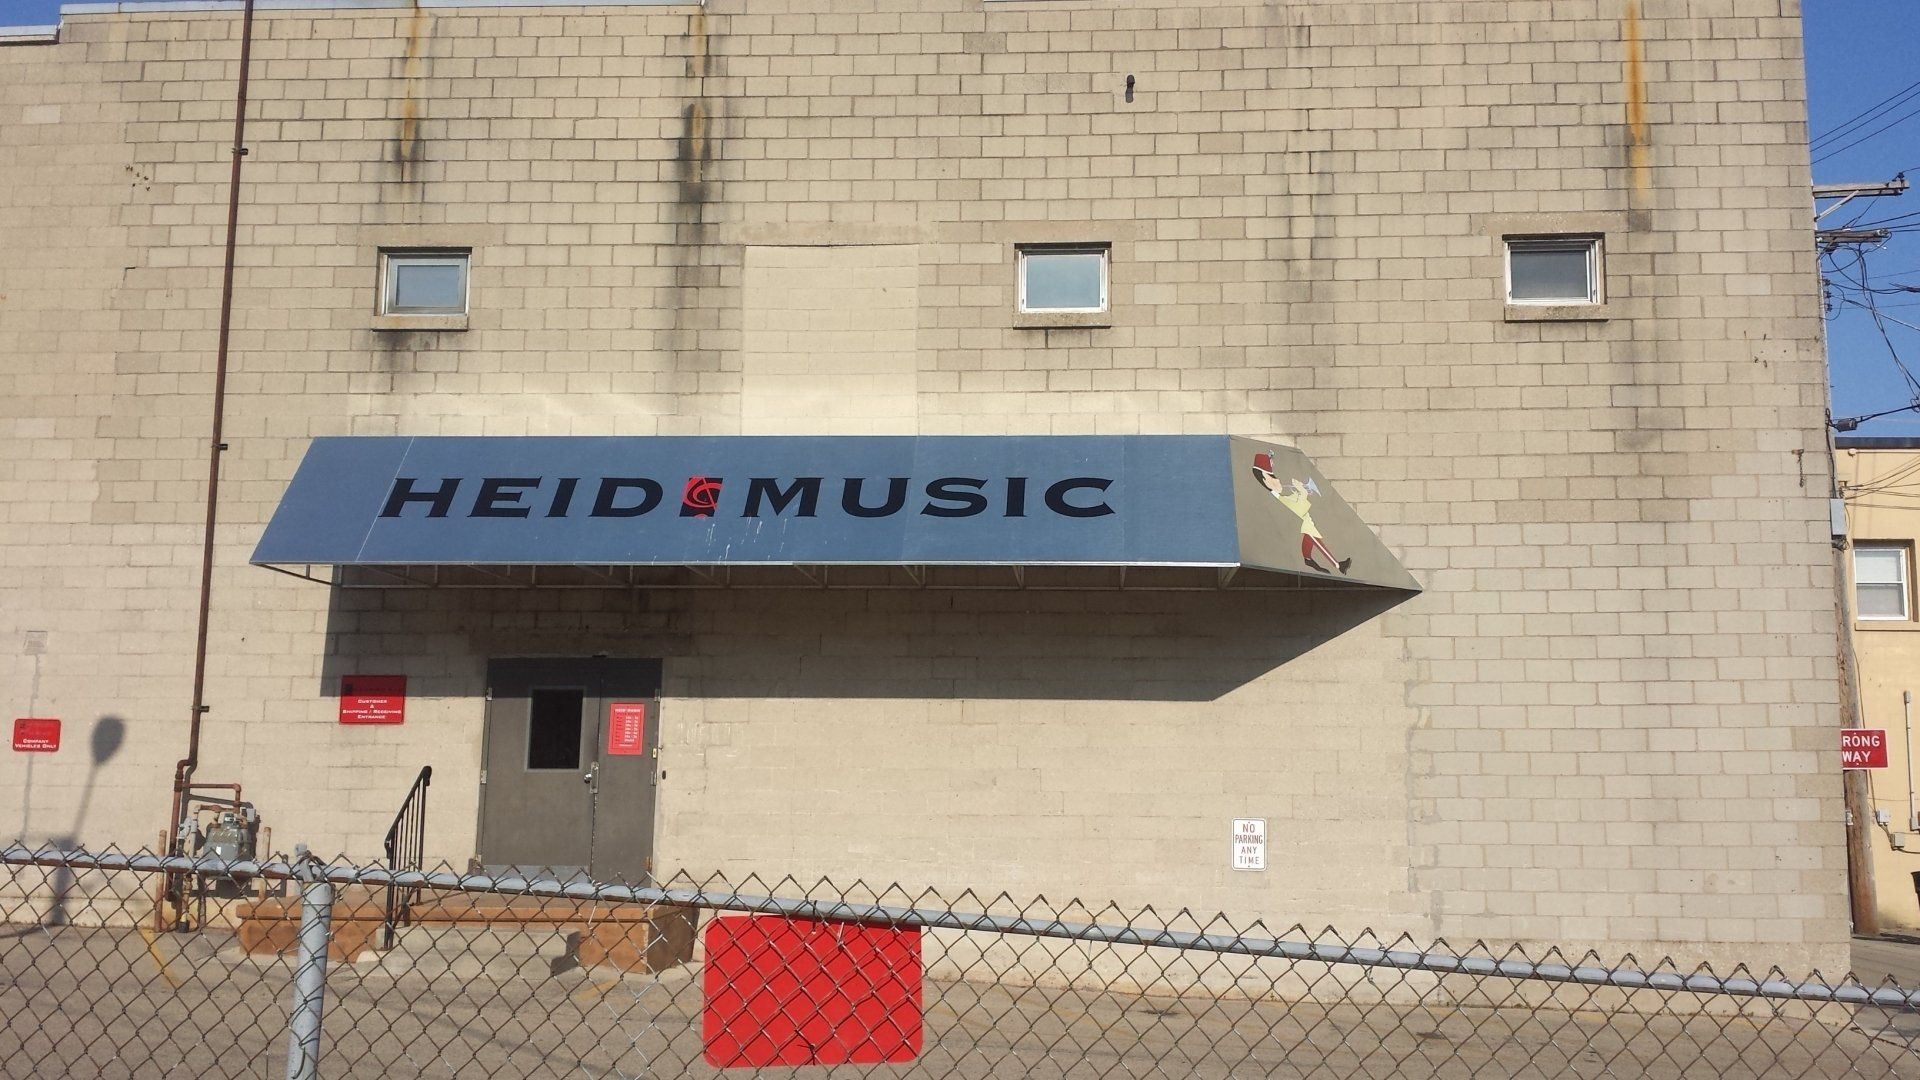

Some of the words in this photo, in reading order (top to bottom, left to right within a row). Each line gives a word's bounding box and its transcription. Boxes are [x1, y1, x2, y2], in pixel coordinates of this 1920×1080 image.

[377, 475, 664, 519] HEID
[740, 476, 1116, 518] MUSIC
[1842, 735, 1881, 747] RONG
[1842, 750, 1872, 763] WAY
[1242, 823, 1256, 833] NO
[1234, 834, 1264, 845] PARKING
[1240, 846, 1258, 855] ANY
[1239, 856, 1260, 865] TIME
